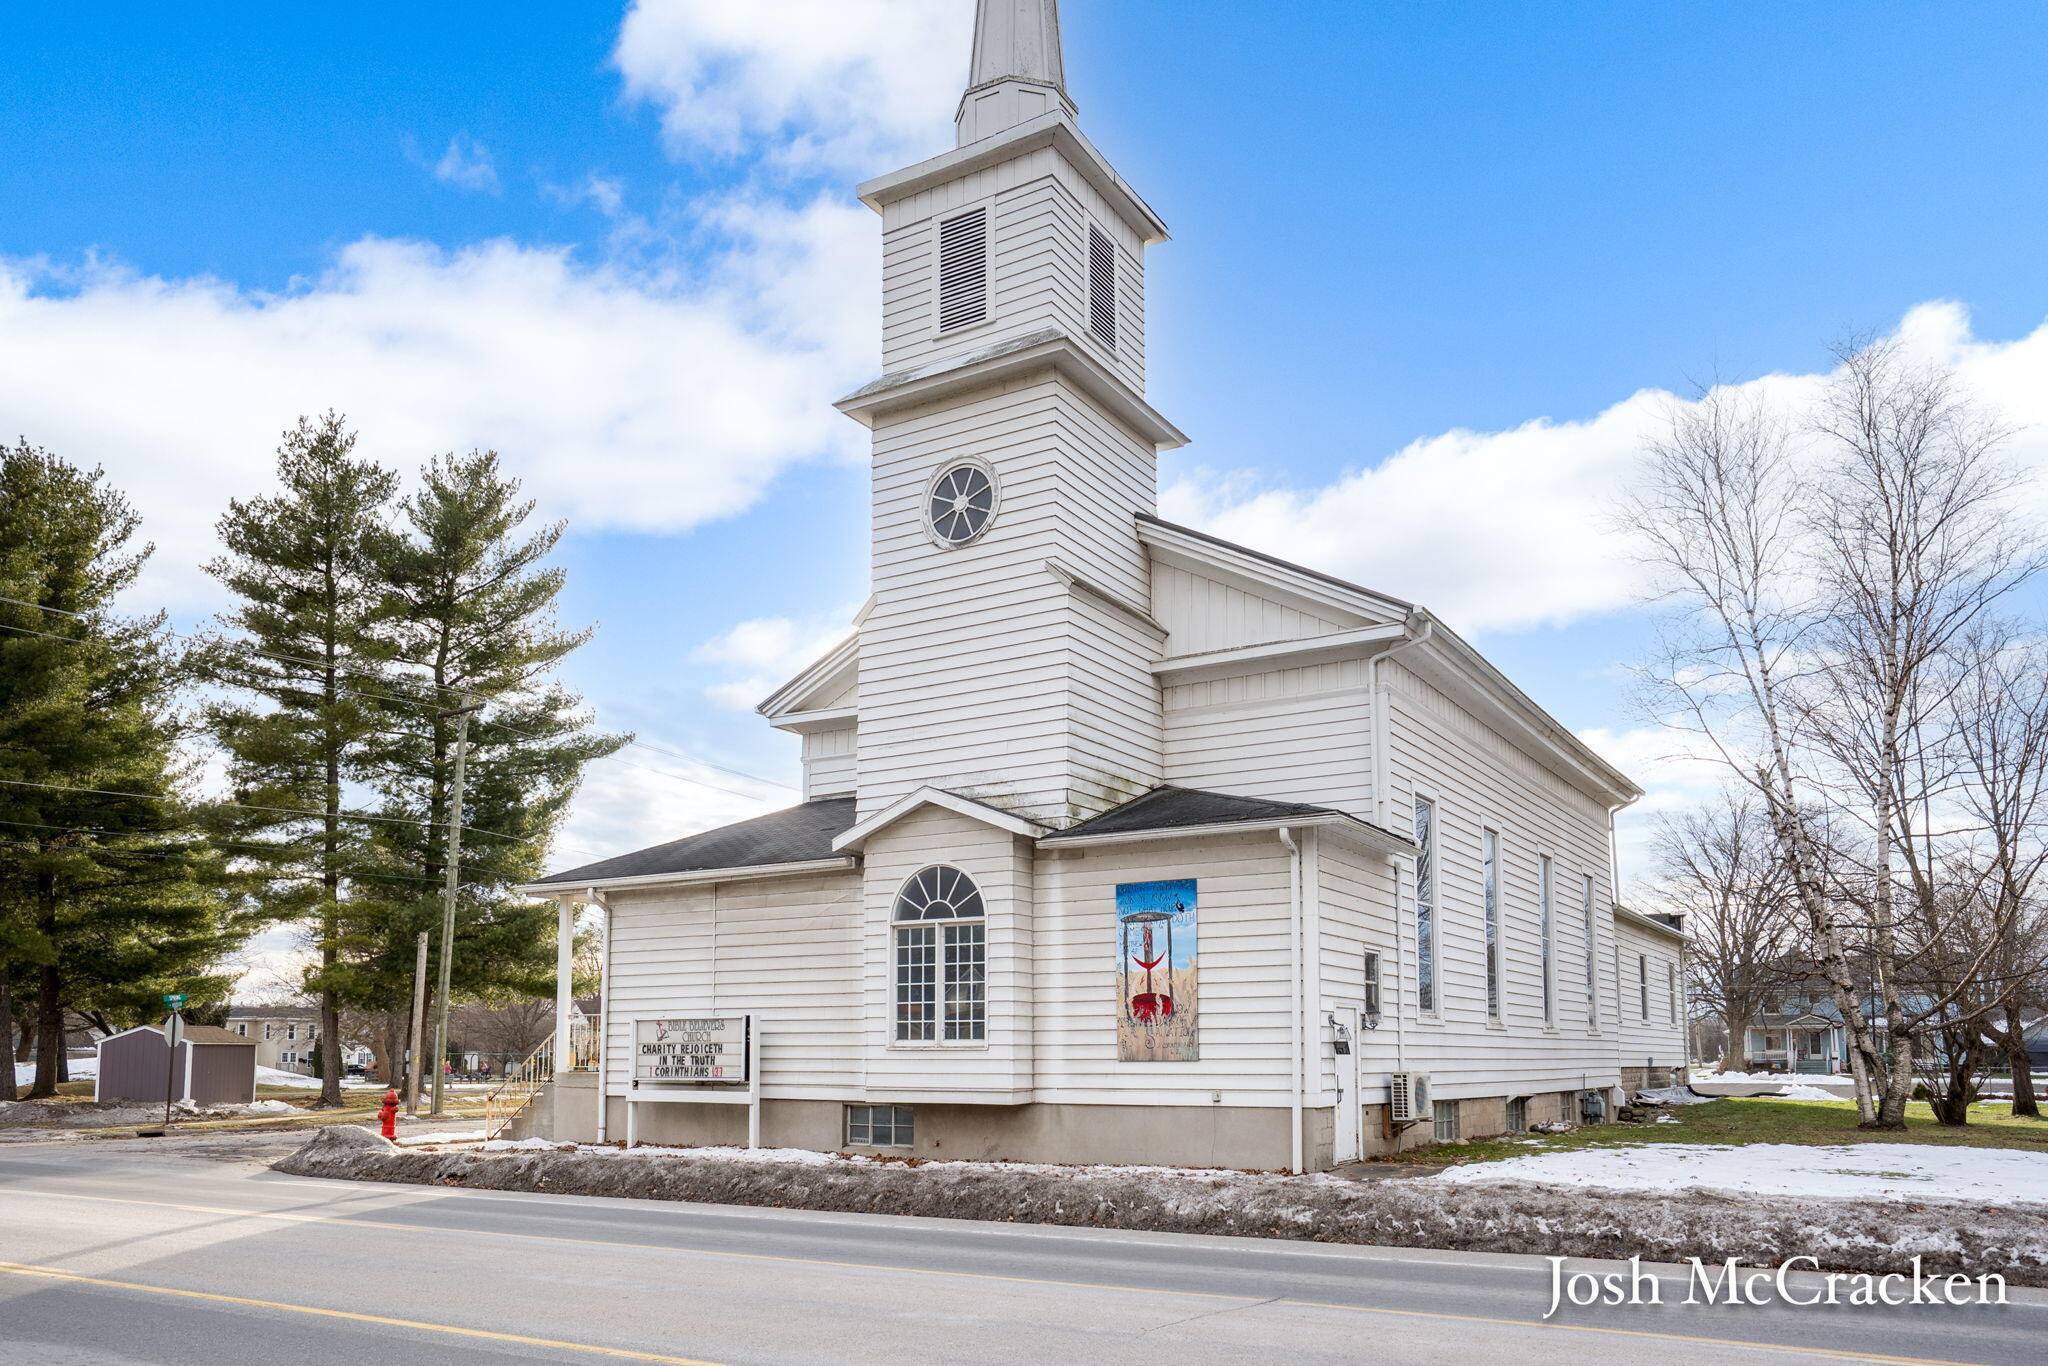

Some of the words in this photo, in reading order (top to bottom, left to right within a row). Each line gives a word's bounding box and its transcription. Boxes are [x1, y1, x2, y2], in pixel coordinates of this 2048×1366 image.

[668, 1020, 687, 1031] BIBLE
[682, 1031, 712, 1042] CHURCH
[642, 1044, 676, 1054] CHARITY
[680, 1043, 723, 1054] REJOICETH
[659, 1056, 667, 1066] IN
[672, 1055, 686, 1066] THE
[691, 1055, 715, 1066] TRUTH
[654, 1067, 709, 1078] CORINTHIANS
